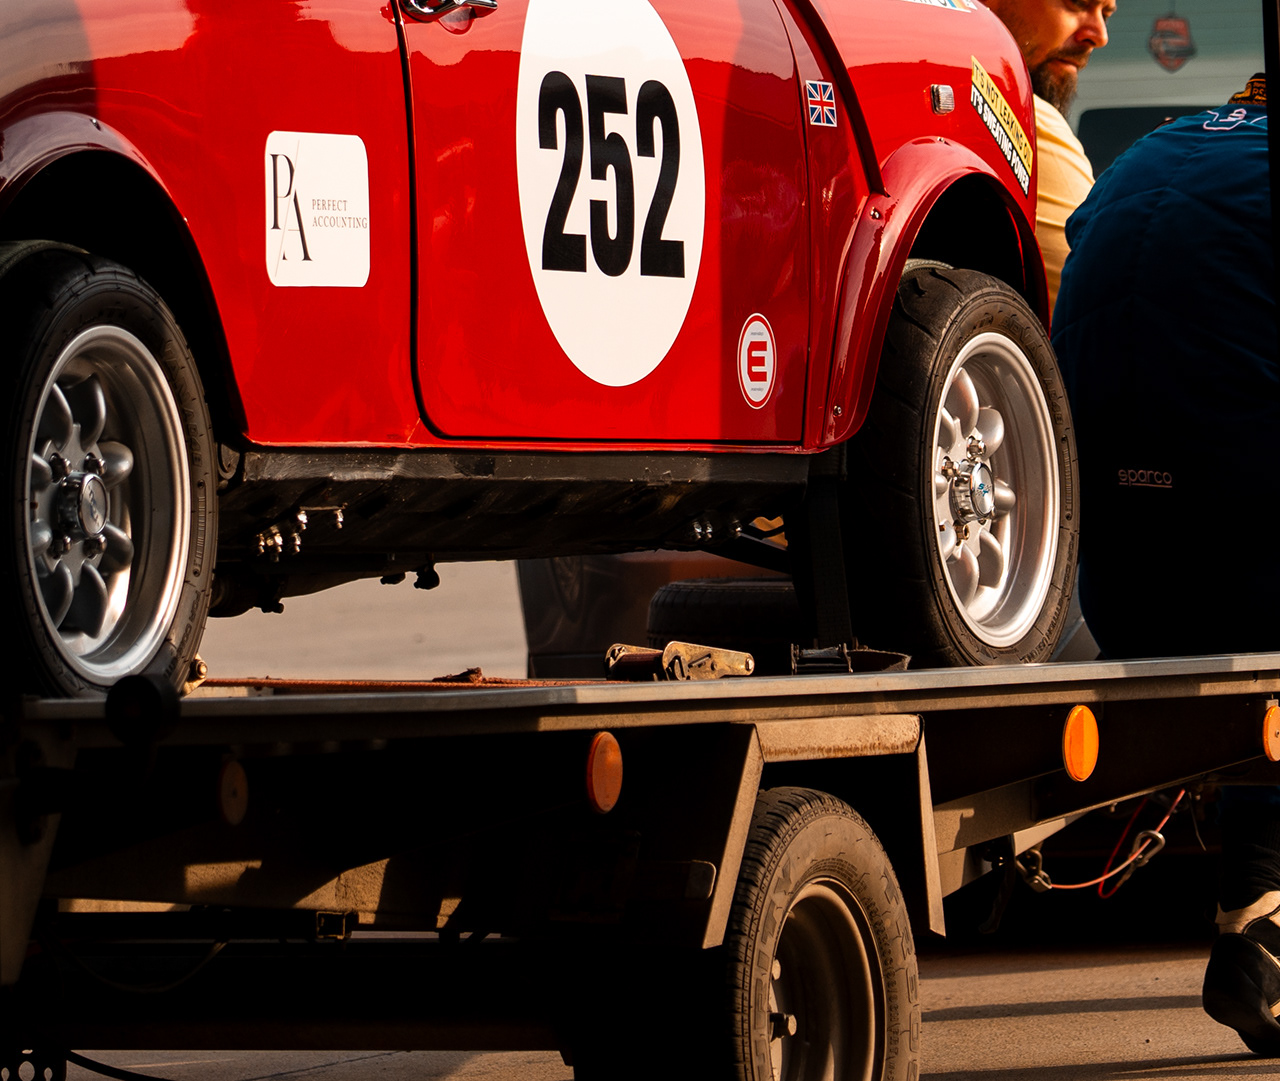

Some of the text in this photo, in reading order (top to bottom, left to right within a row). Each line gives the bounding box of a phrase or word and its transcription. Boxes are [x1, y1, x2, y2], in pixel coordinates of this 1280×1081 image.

[973, 61, 985, 89] IT'S
[986, 80, 999, 107] NOT
[999, 100, 1023, 150] LEAKING
[971, 84, 1030, 196] IT'S SWEATING POWER
[537, 70, 685, 278] 252
[312, 199, 348, 212] PERFECT
[312, 216, 368, 229] ACCOUNTING
[1117, 469, 1173, 487] sparco
